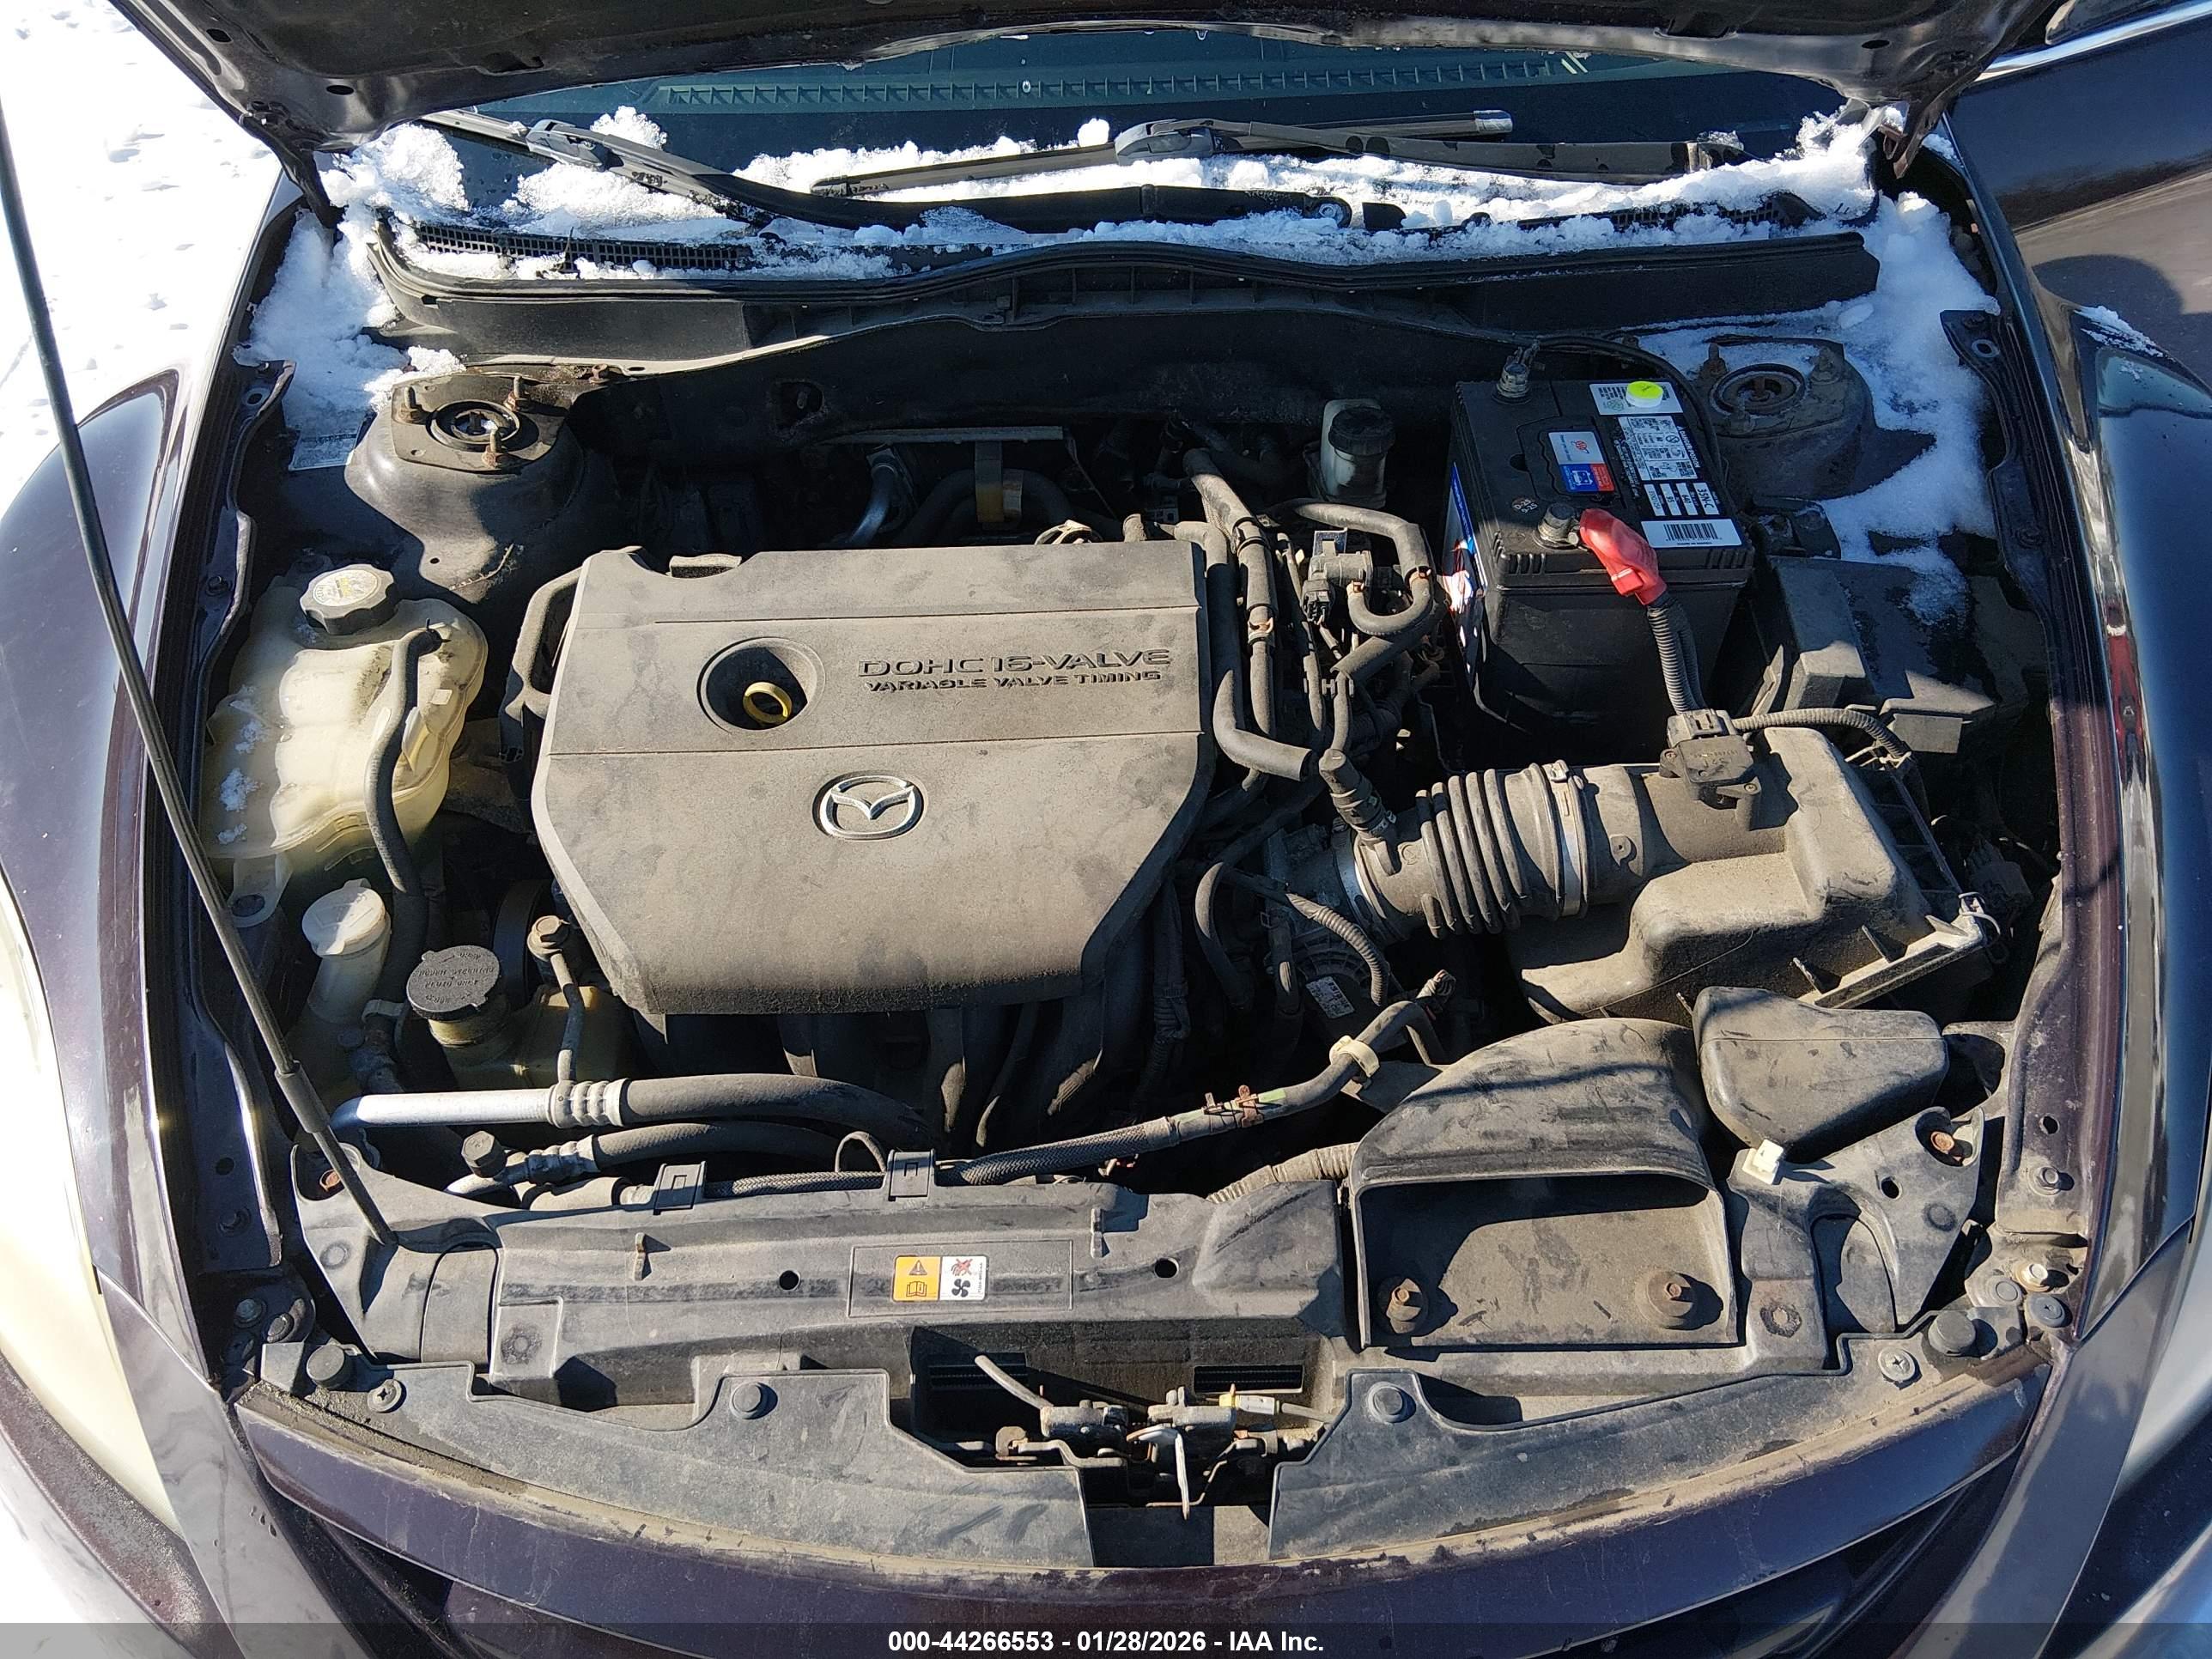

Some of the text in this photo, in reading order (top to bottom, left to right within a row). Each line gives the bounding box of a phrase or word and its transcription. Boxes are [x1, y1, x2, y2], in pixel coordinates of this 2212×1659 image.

[1681, 494, 1692, 504] 640
[1697, 488, 1715, 509] 35N-C
[859, 648, 1171, 677] DOHC 16-VALVE
[866, 671, 1161, 693] VARIABLE VALVE TIMING
